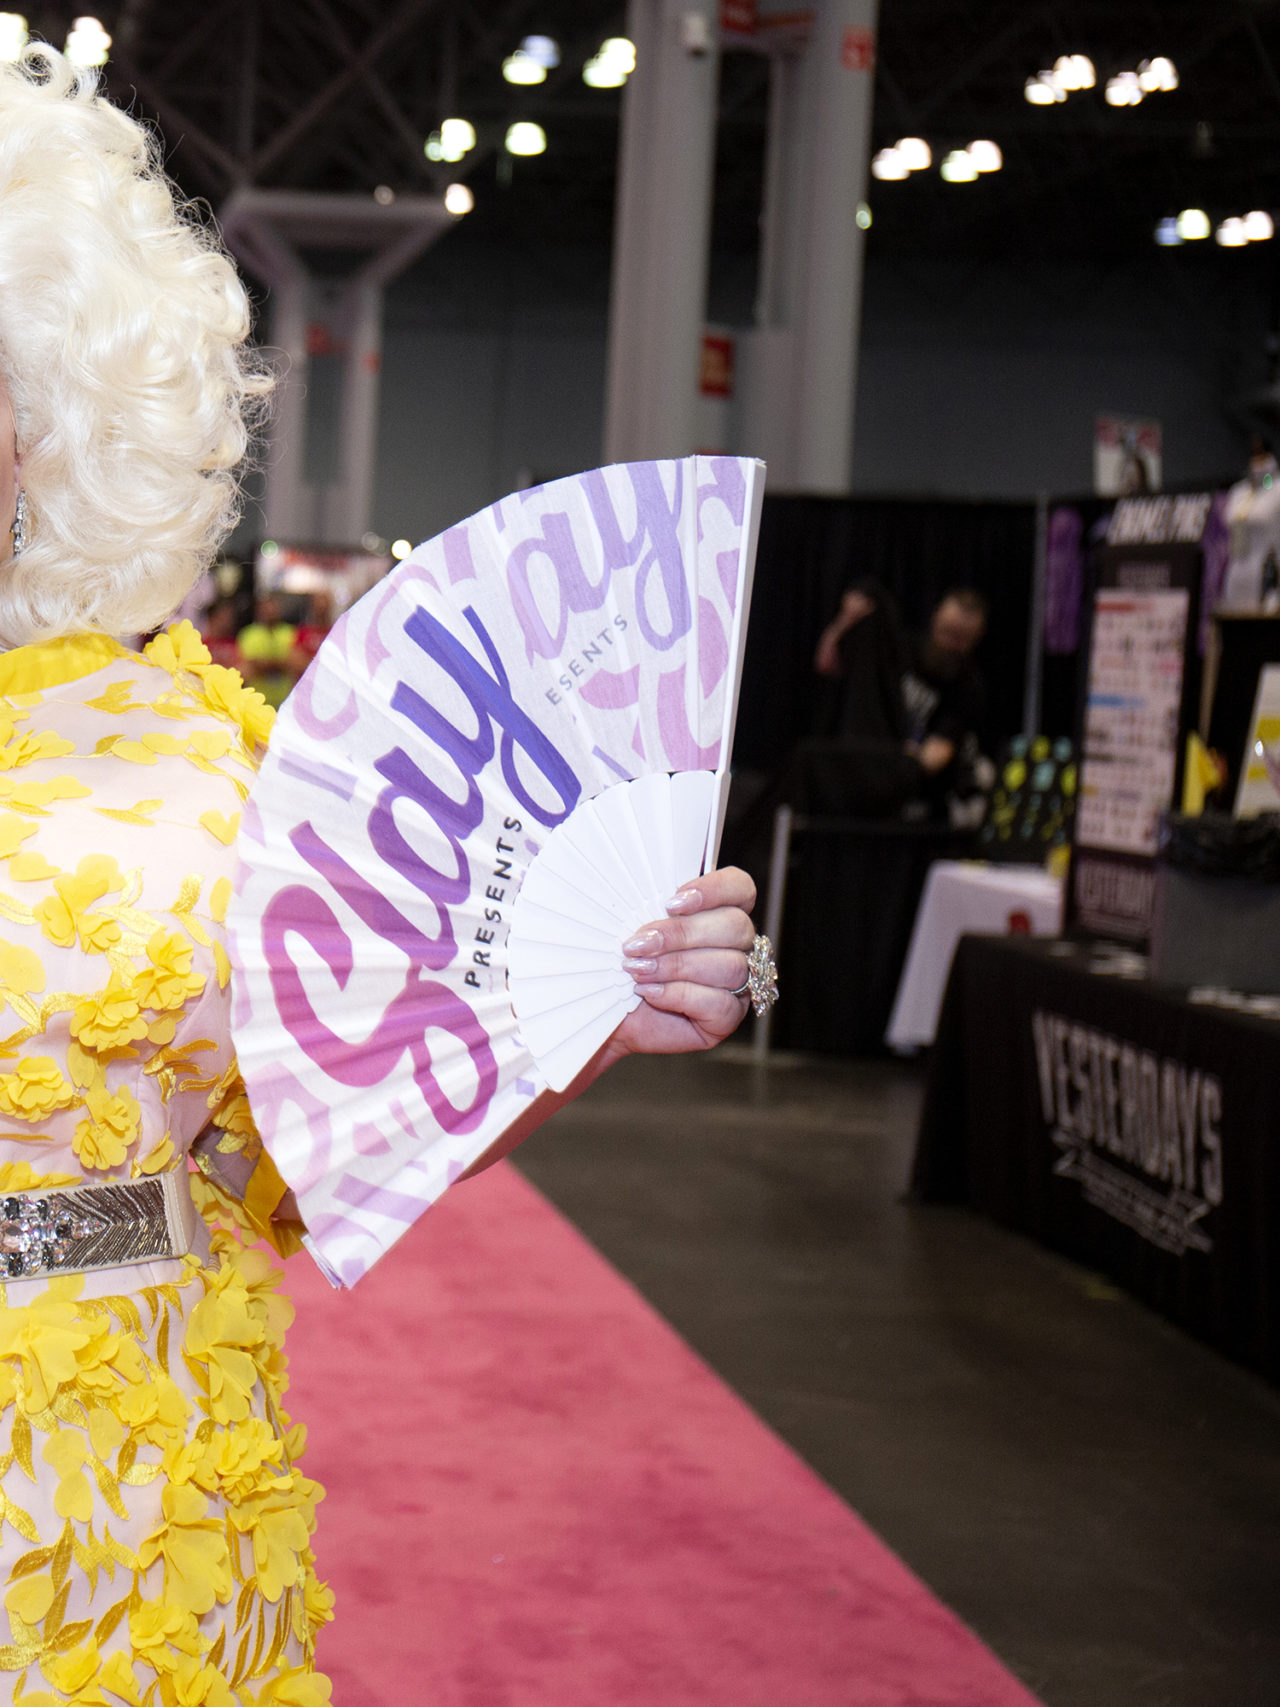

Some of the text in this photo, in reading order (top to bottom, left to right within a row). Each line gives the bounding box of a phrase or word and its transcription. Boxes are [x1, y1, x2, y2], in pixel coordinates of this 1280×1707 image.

[261, 604, 582, 1136] Slay
[464, 816, 522, 989] PRESENTS
[1031, 1009, 1222, 1206] YESTERDAYS
